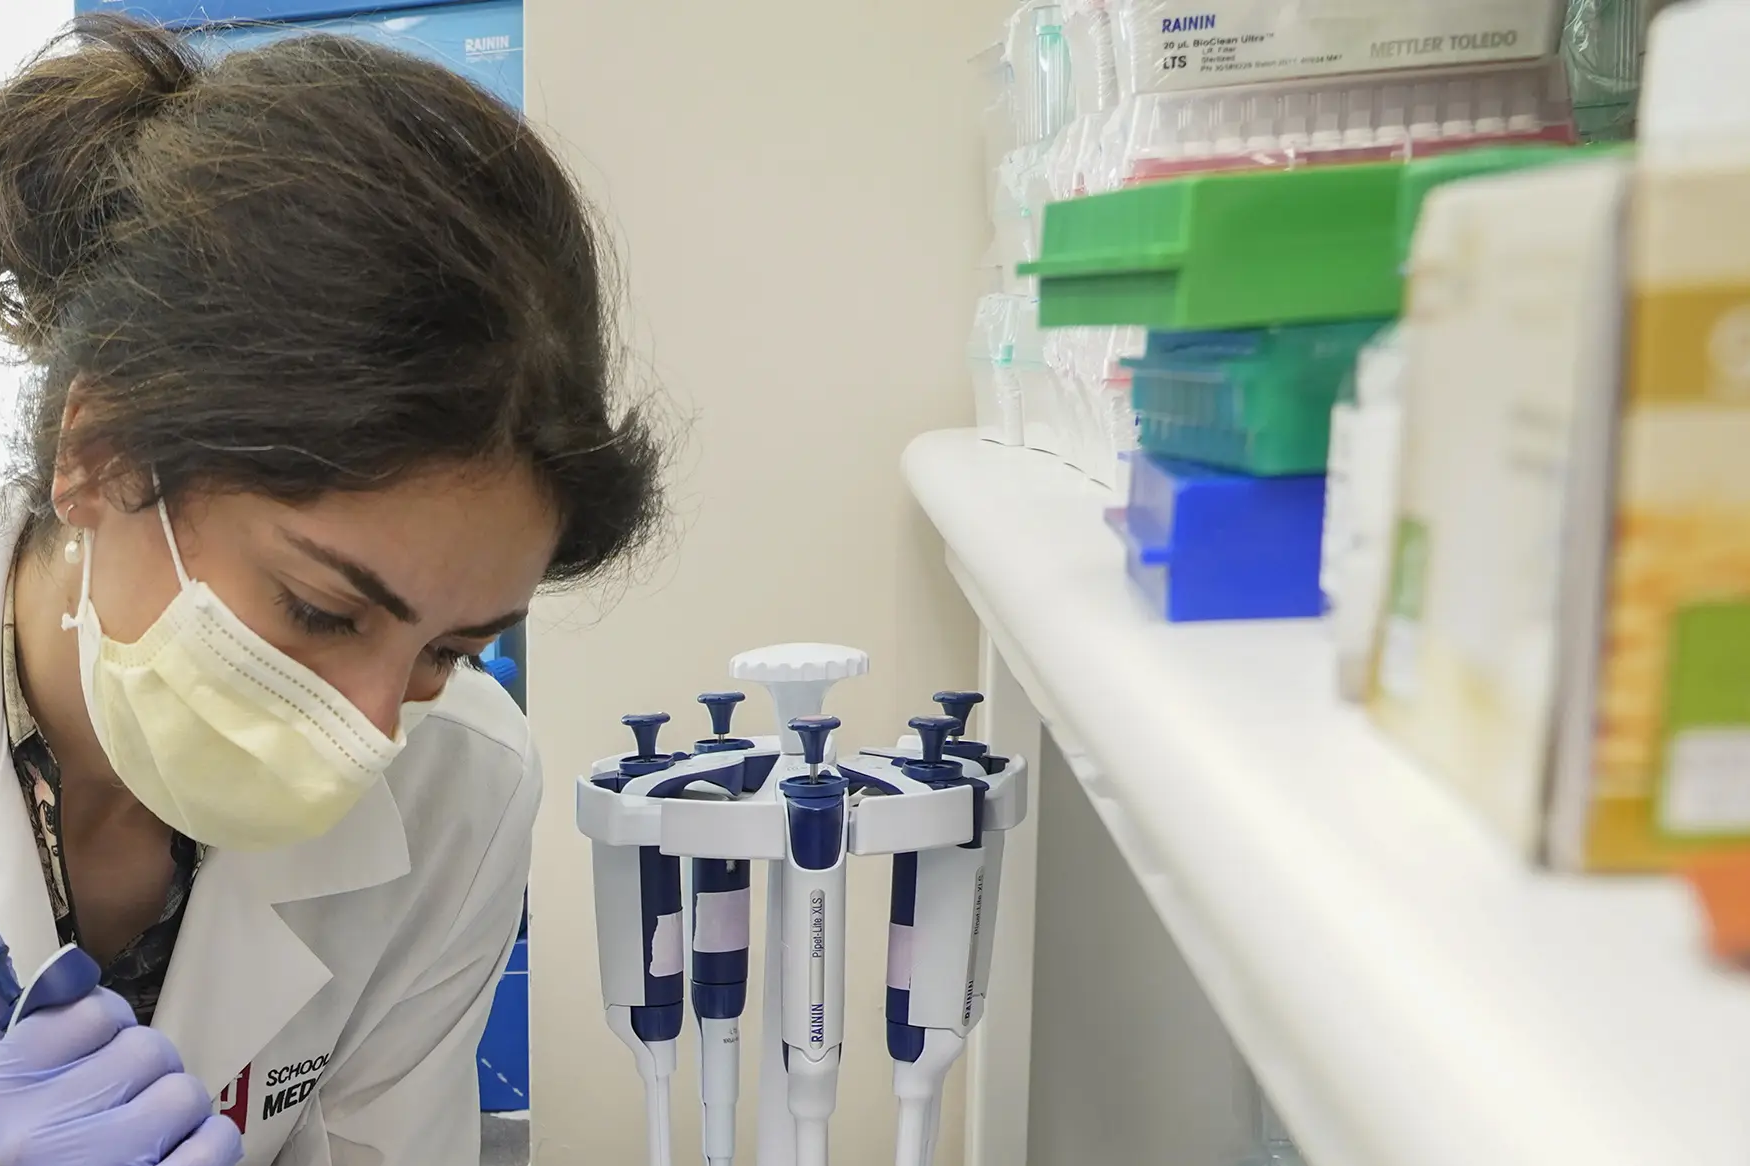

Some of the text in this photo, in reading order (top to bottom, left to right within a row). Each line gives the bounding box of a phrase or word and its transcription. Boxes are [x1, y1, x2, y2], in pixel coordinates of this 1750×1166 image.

[1161, 14, 1217, 34] RAININ
[464, 35, 510, 52] RAININ
[1192, 36, 1238, 48] BioClean
[1370, 29, 1518, 58] METTLER TOLEDO
[1162, 55, 1188, 70] LTS
[811, 897, 825, 958] Pipet-Lite XLS
[811, 1003, 825, 1043] RAININ
[265, 1053, 330, 1087] SCHOOL
